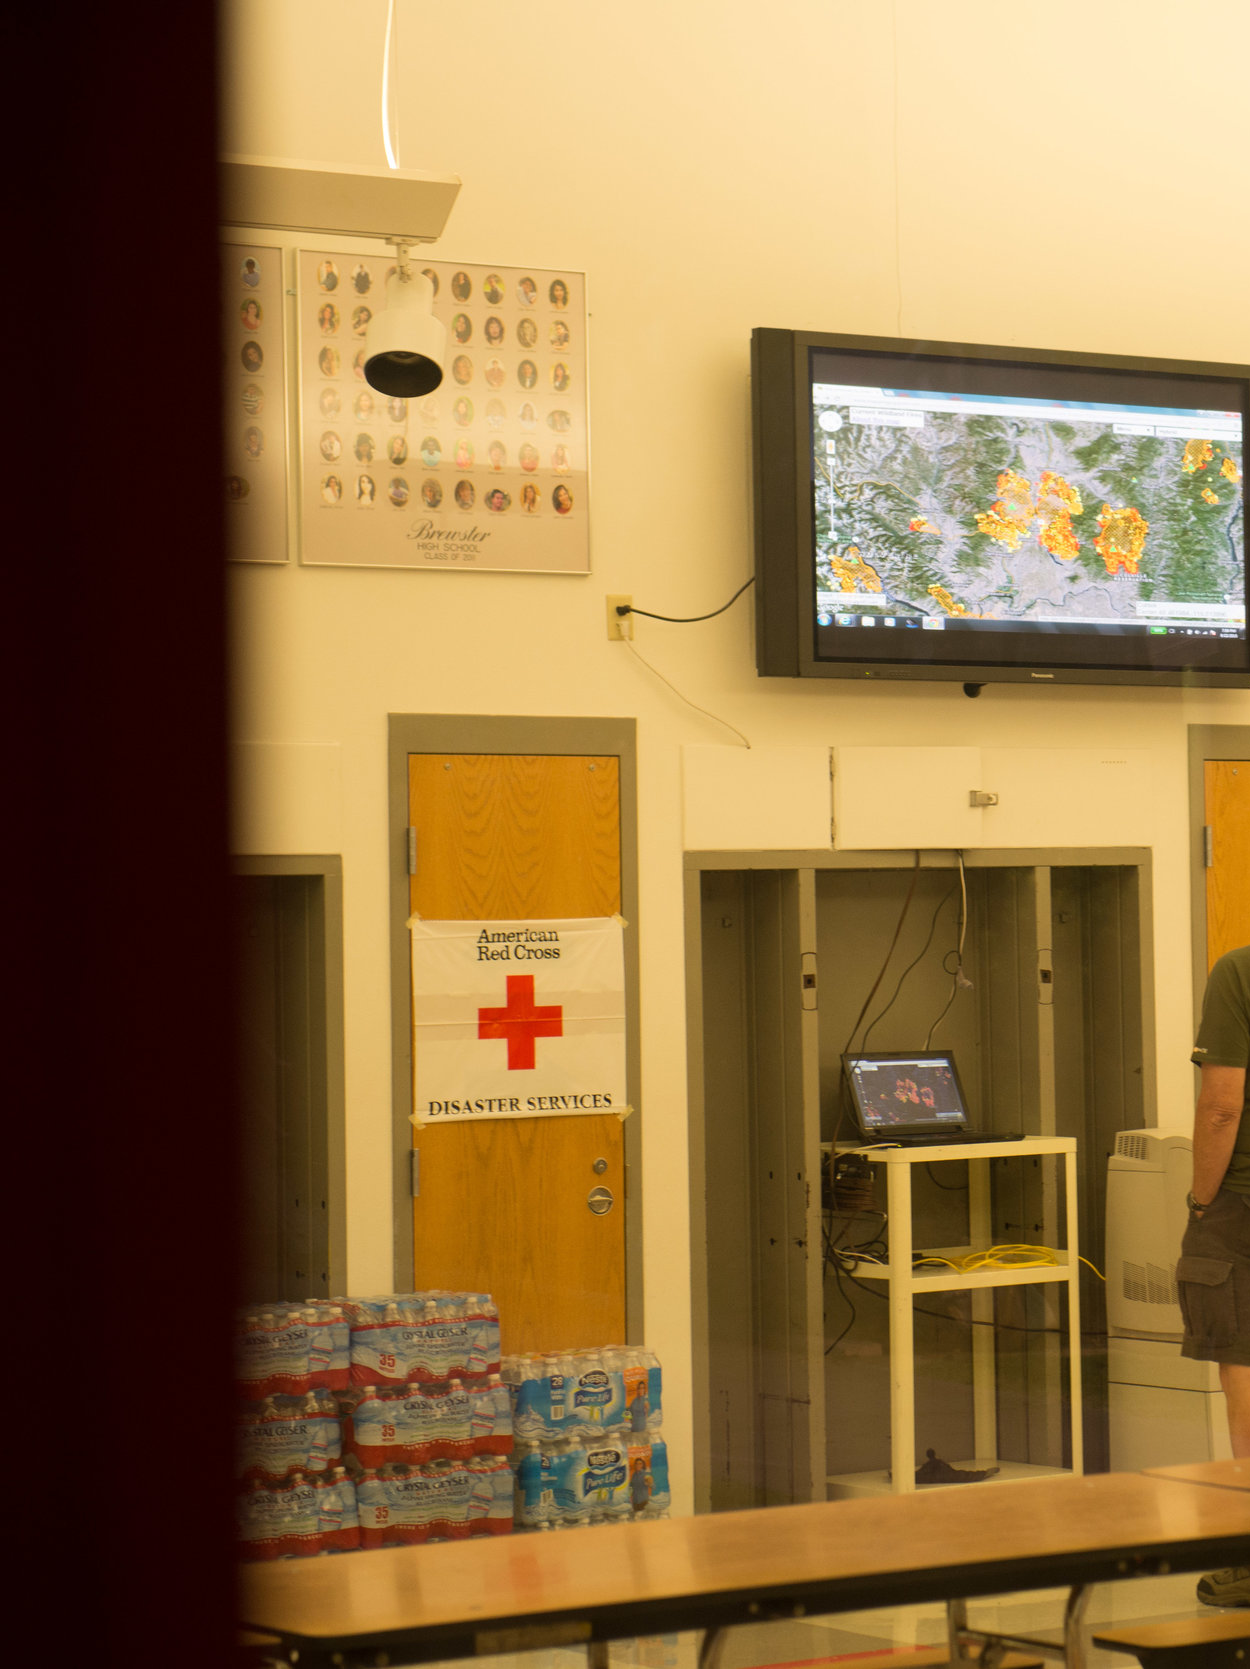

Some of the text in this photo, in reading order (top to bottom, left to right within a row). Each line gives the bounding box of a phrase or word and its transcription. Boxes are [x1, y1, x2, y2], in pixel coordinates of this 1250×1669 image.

[407, 519, 491, 542] Brewster
[417, 541, 480, 553] HIGH SCHOOL
[476, 928, 560, 944] American
[477, 944, 561, 961] Red Cross
[428, 1093, 613, 1116] DISASTER SERVICES
[379, 1353, 396, 1368] 35
[551, 1375, 563, 1387] 28
[381, 1424, 396, 1438] 35
[586, 1470, 624, 1490] Pure Life
[375, 1506, 389, 1519] 35
